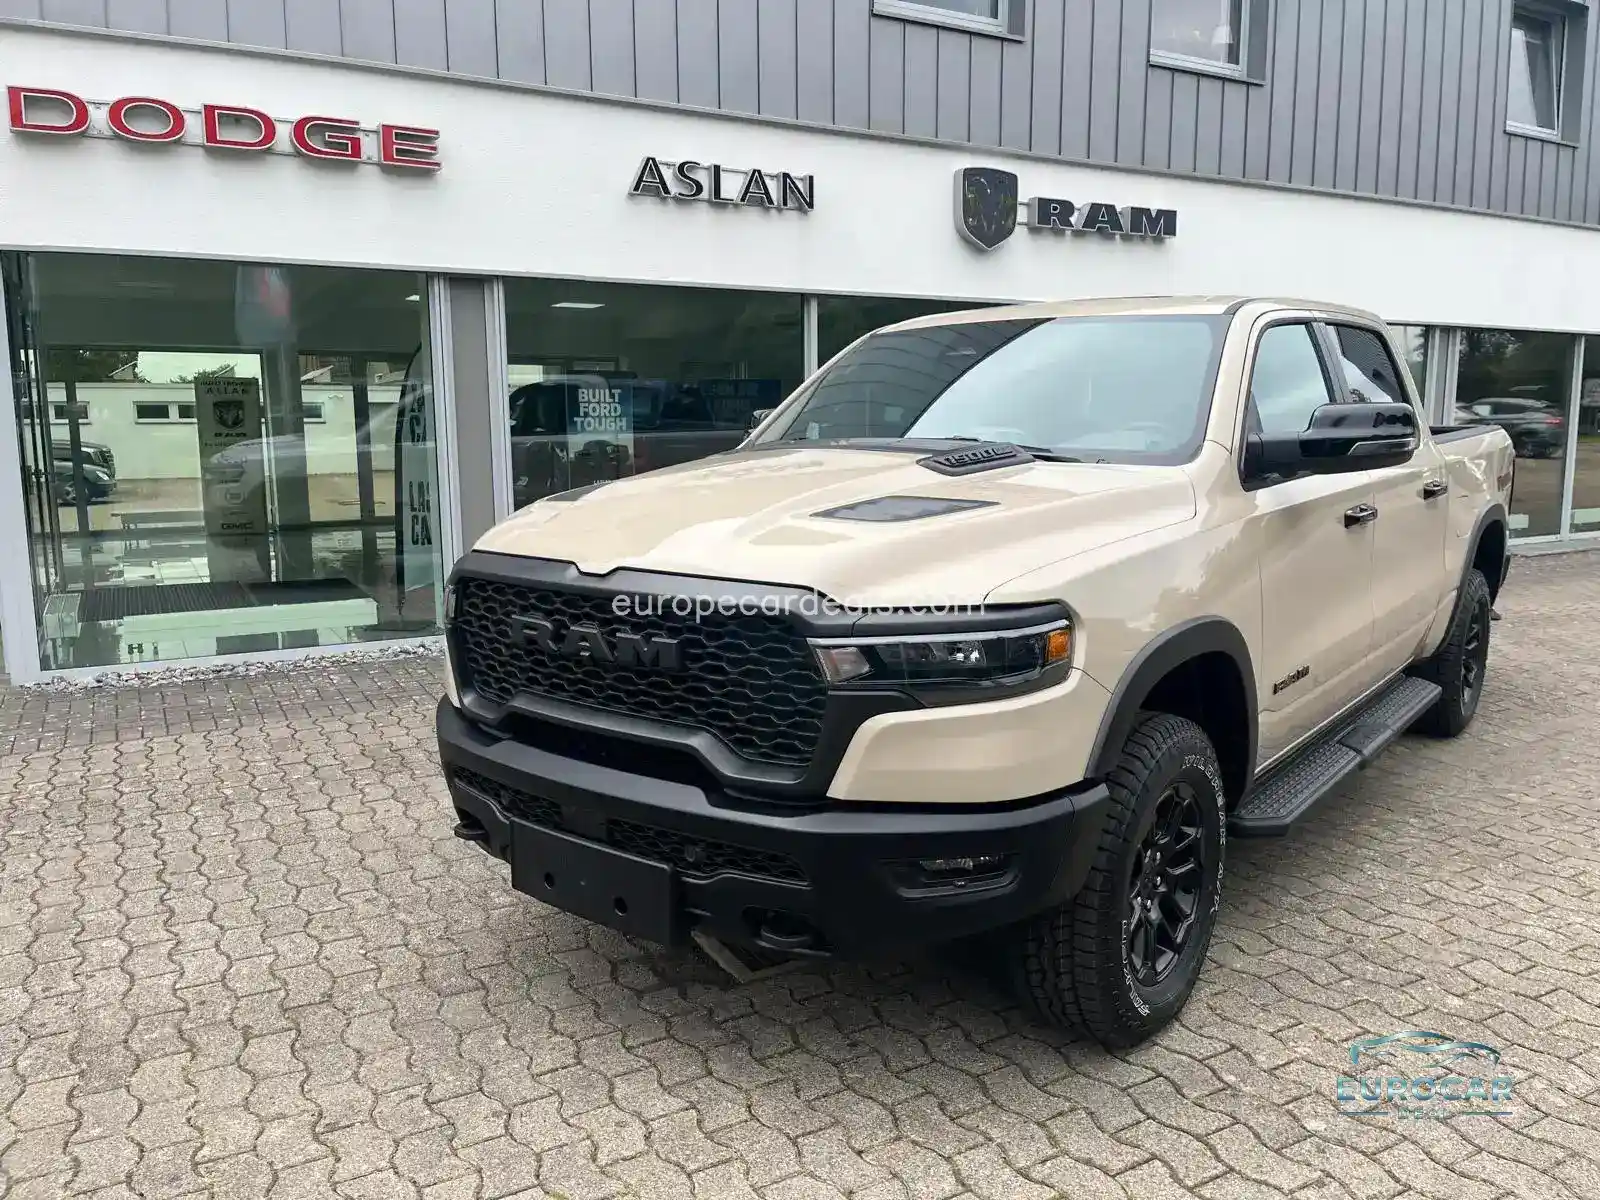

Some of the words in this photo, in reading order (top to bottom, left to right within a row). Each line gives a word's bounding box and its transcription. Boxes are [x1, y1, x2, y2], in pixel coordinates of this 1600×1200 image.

[7, 85, 442, 172] DODGE
[628, 156, 815, 212] ASLAN
[1028, 196, 1178, 237] RAM
[577, 388, 622, 402] BUILT
[578, 402, 622, 417] FORD
[573, 416, 627, 432] TOUGH
[509, 614, 682, 671] RAM
